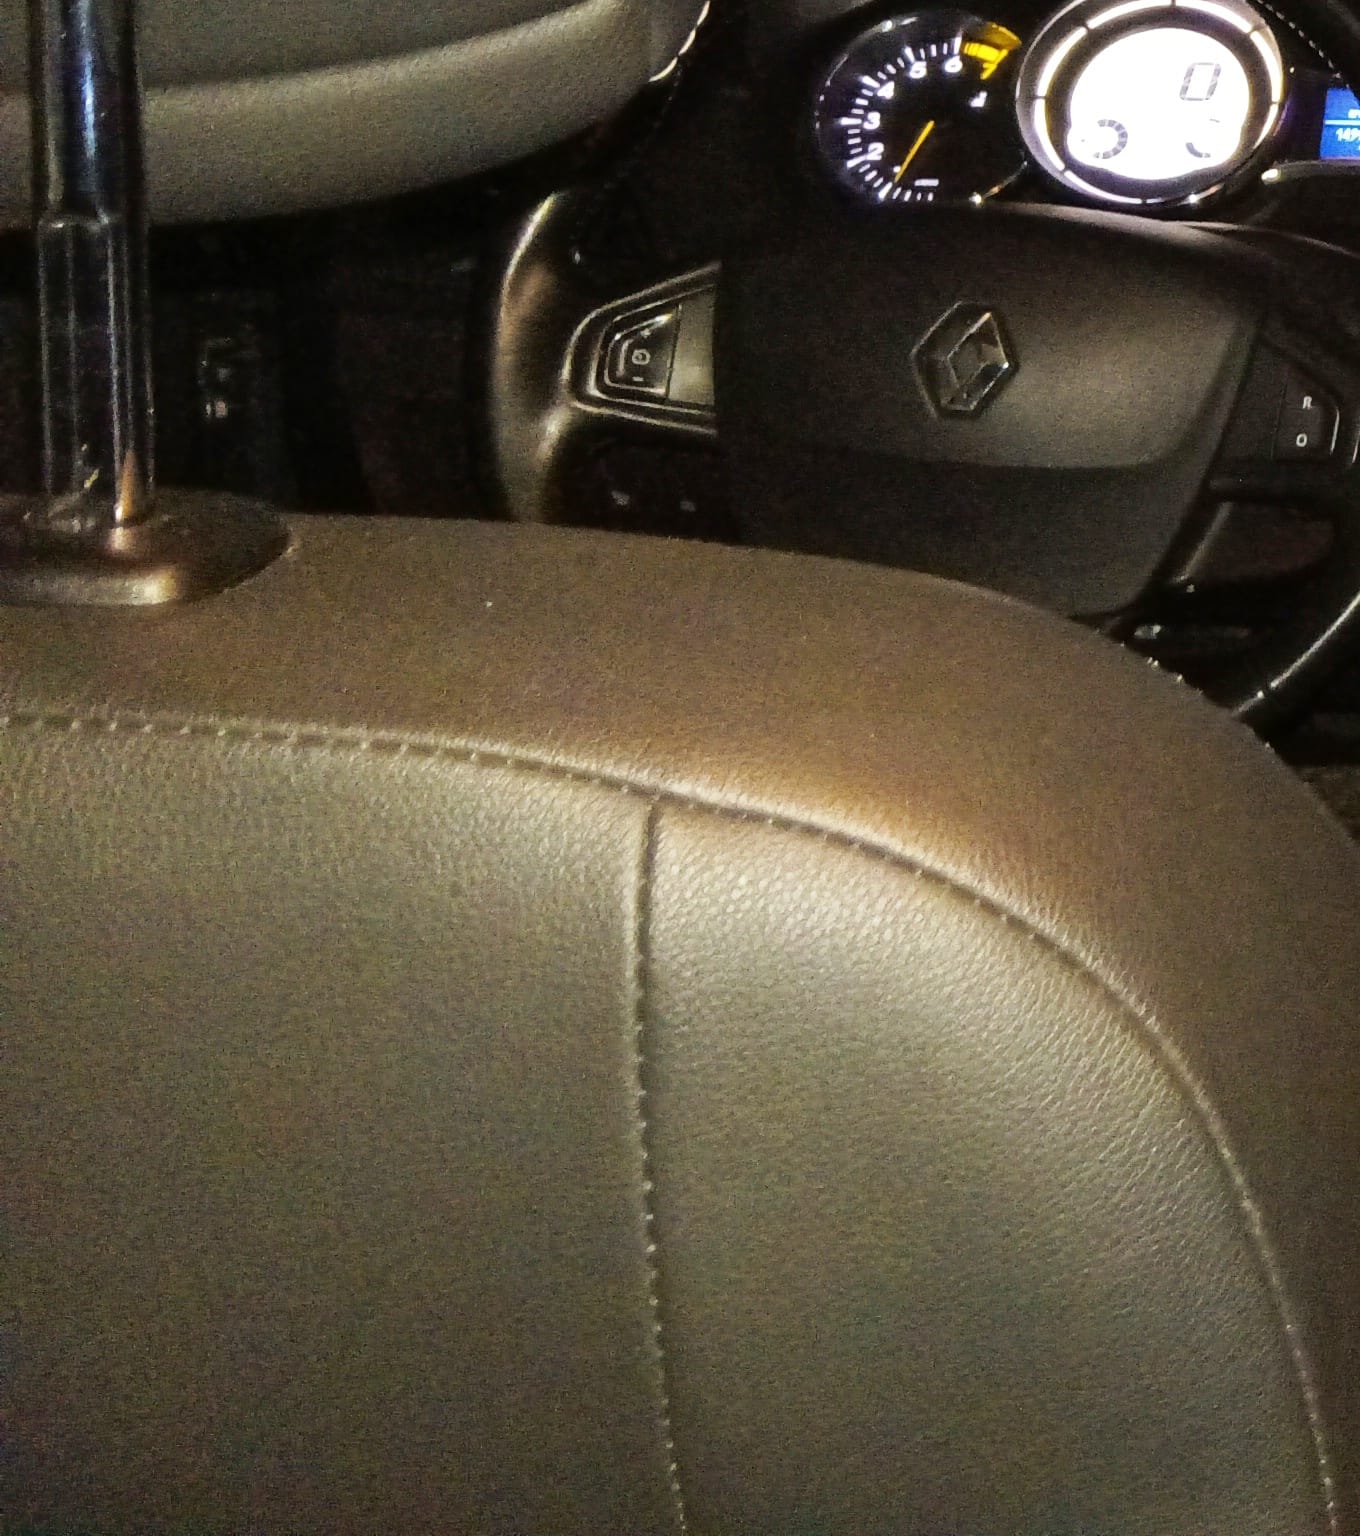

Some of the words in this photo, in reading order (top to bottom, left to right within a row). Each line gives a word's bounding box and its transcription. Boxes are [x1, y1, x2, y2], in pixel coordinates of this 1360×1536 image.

[909, 60, 927, 79] 5
[944, 55, 963, 73] 6
[877, 80, 895, 100] 4
[1179, 62, 1222, 102] 0
[863, 111, 881, 130] 3
[866, 142, 885, 161] 2
